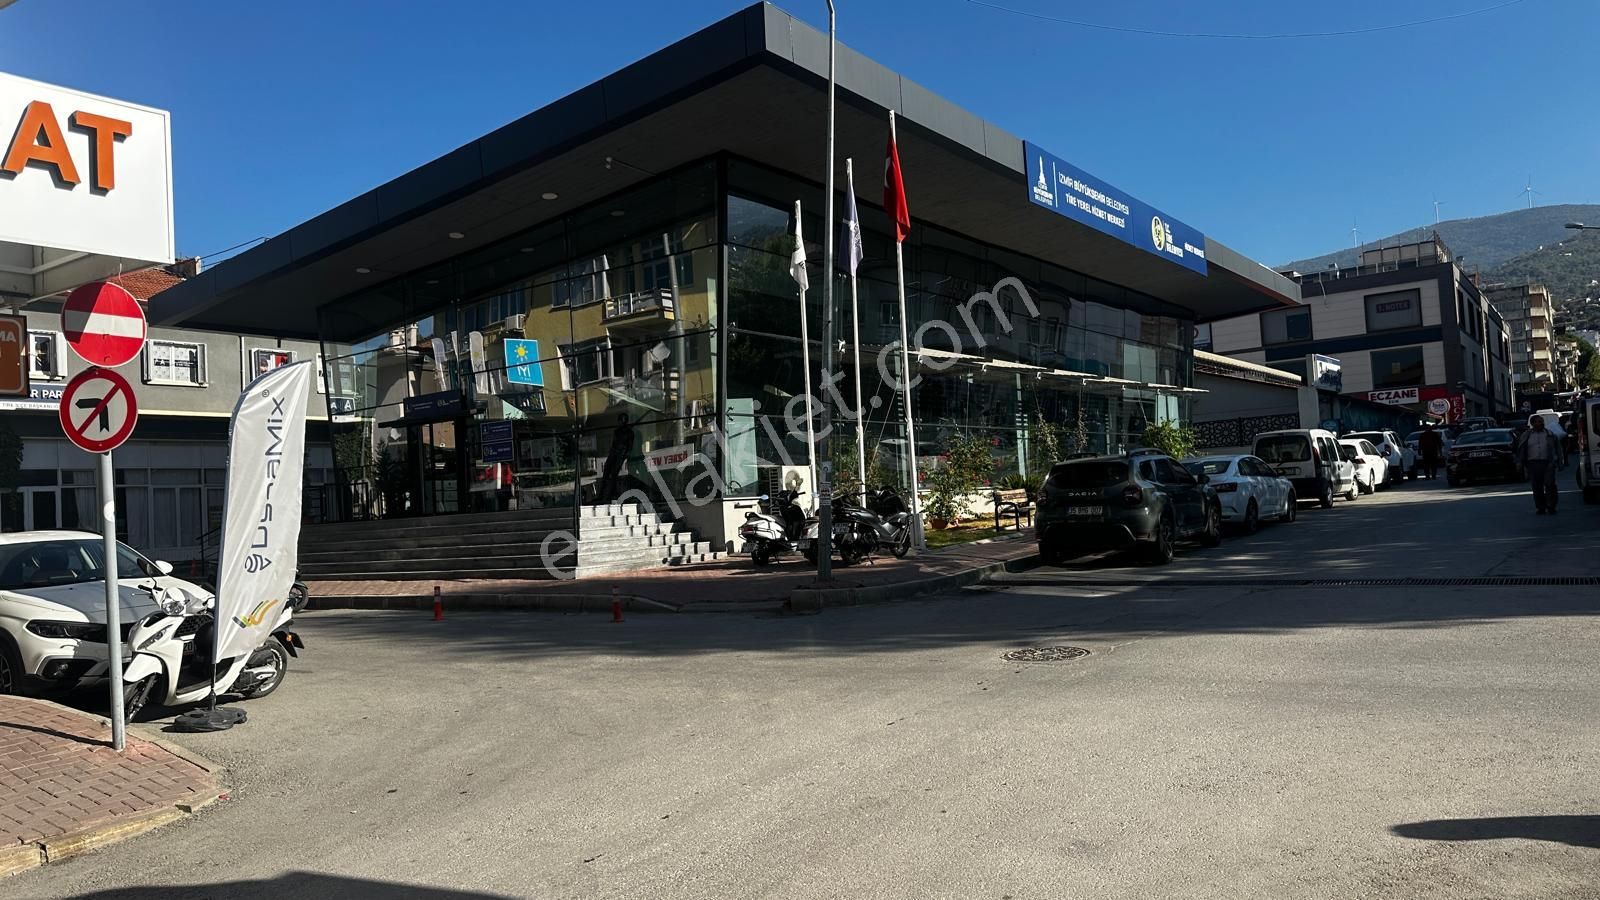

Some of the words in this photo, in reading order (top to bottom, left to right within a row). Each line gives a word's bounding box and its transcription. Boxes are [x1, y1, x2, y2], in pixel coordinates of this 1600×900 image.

[30, 389, 39, 398] R
[42, 389, 64, 398] PAR
[1370, 389, 1416, 401] ECZANE
